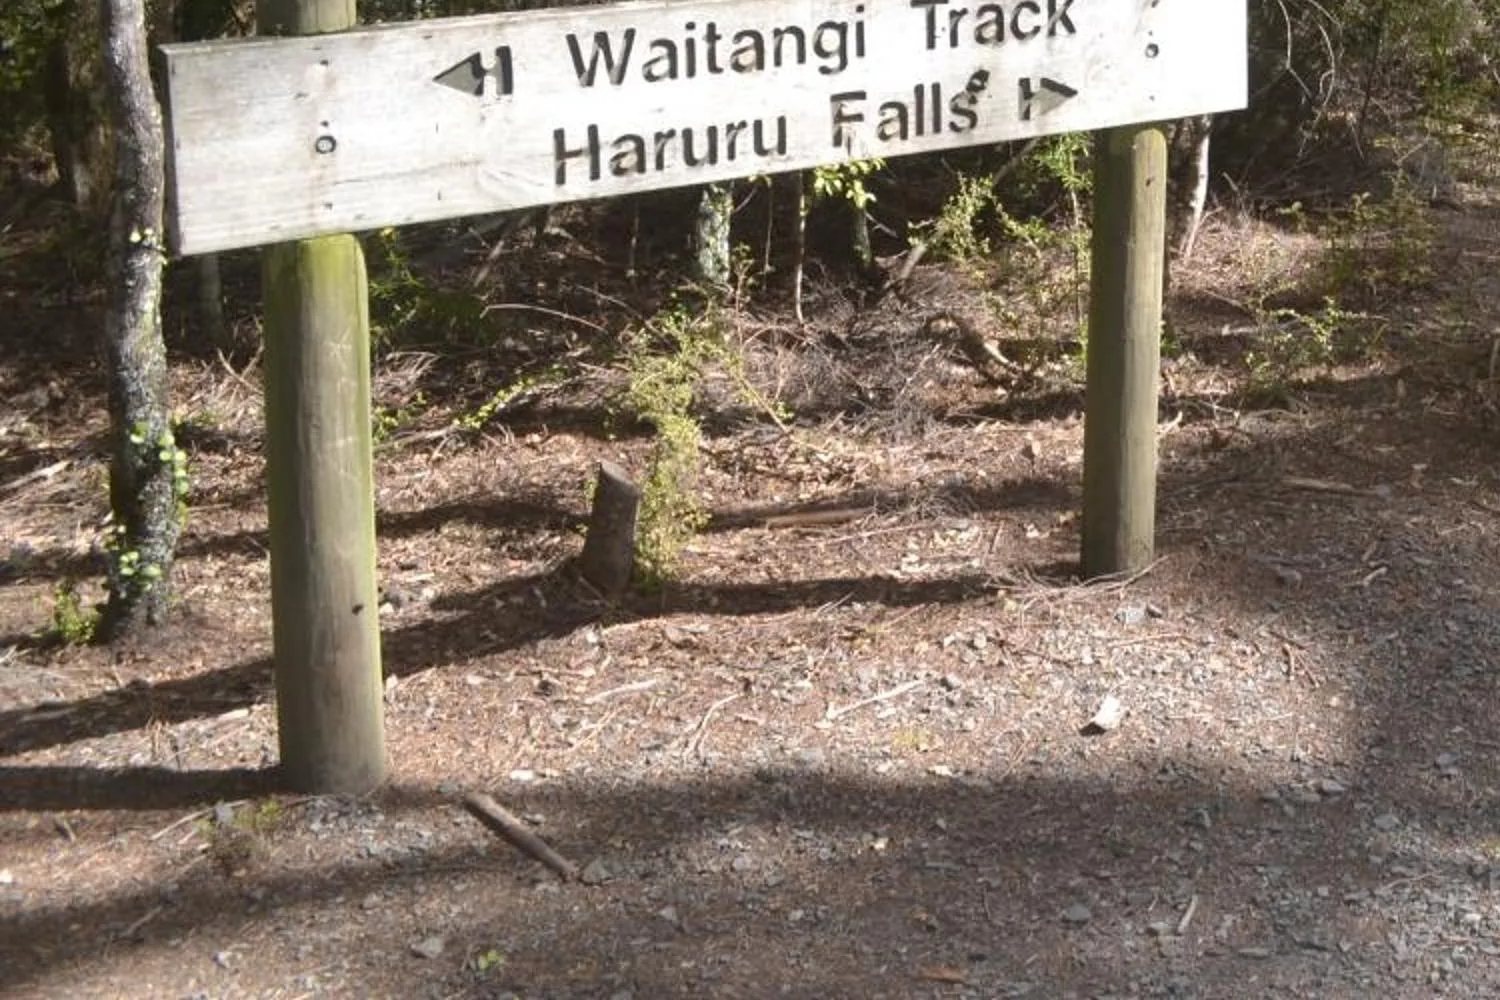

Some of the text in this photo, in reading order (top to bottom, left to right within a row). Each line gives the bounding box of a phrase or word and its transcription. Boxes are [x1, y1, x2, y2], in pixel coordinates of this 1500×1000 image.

[566, 4, 866, 88] Waitangi
[553, 82, 979, 187] Haruru Falls
